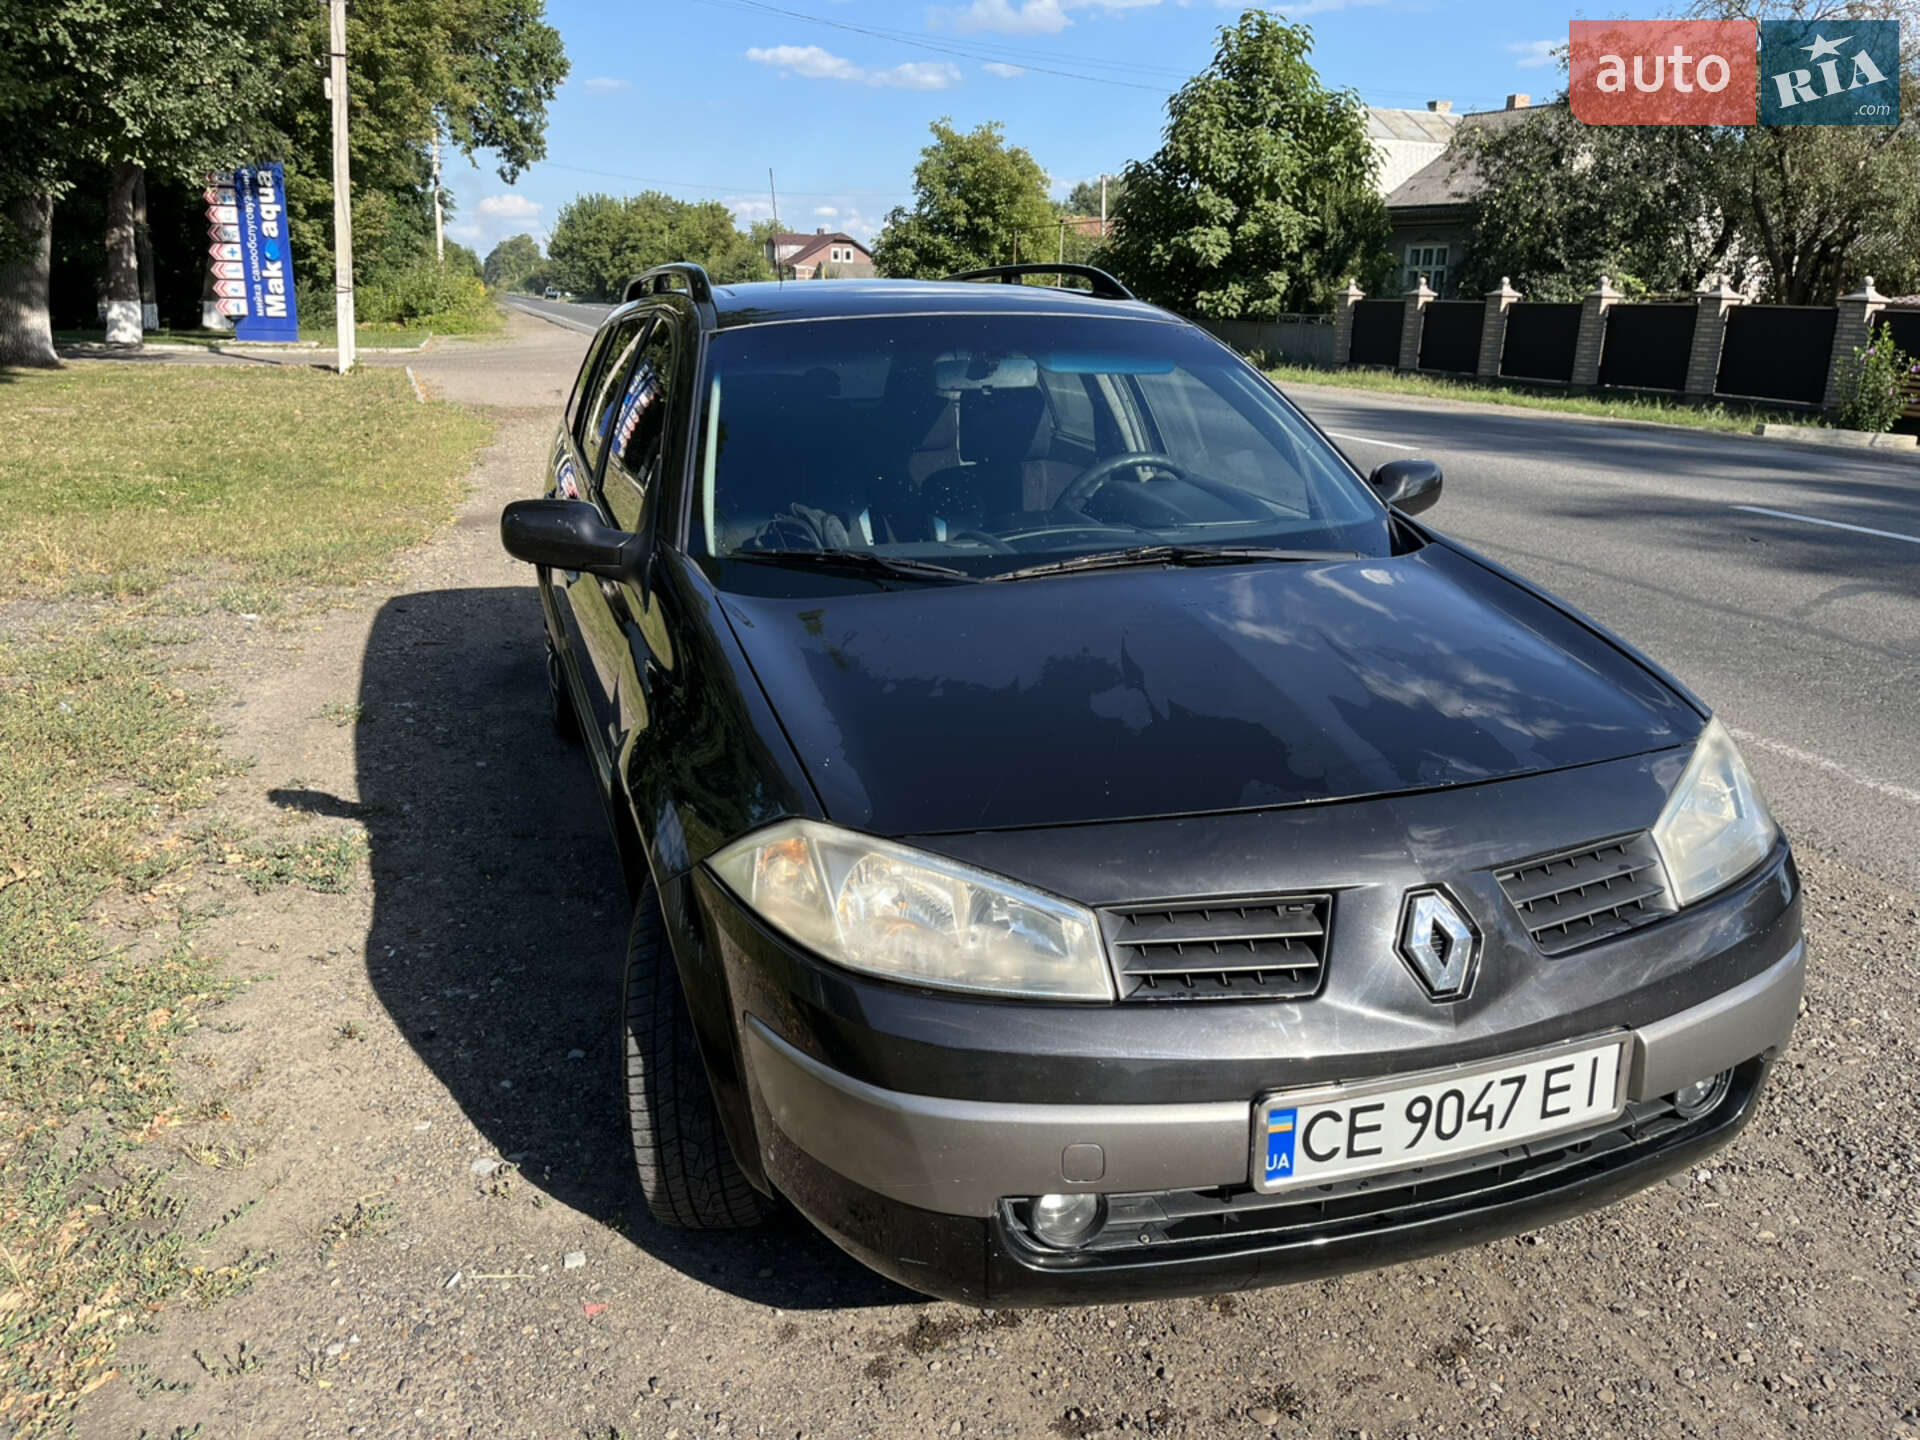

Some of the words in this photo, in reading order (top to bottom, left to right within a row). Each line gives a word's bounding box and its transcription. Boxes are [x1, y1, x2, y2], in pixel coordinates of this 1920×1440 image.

[257, 170, 281, 239] aqua
[1301, 1102, 1385, 1162] CE
[1404, 1074, 1527, 1150] 9047
[1265, 1153, 1290, 1171] UA
